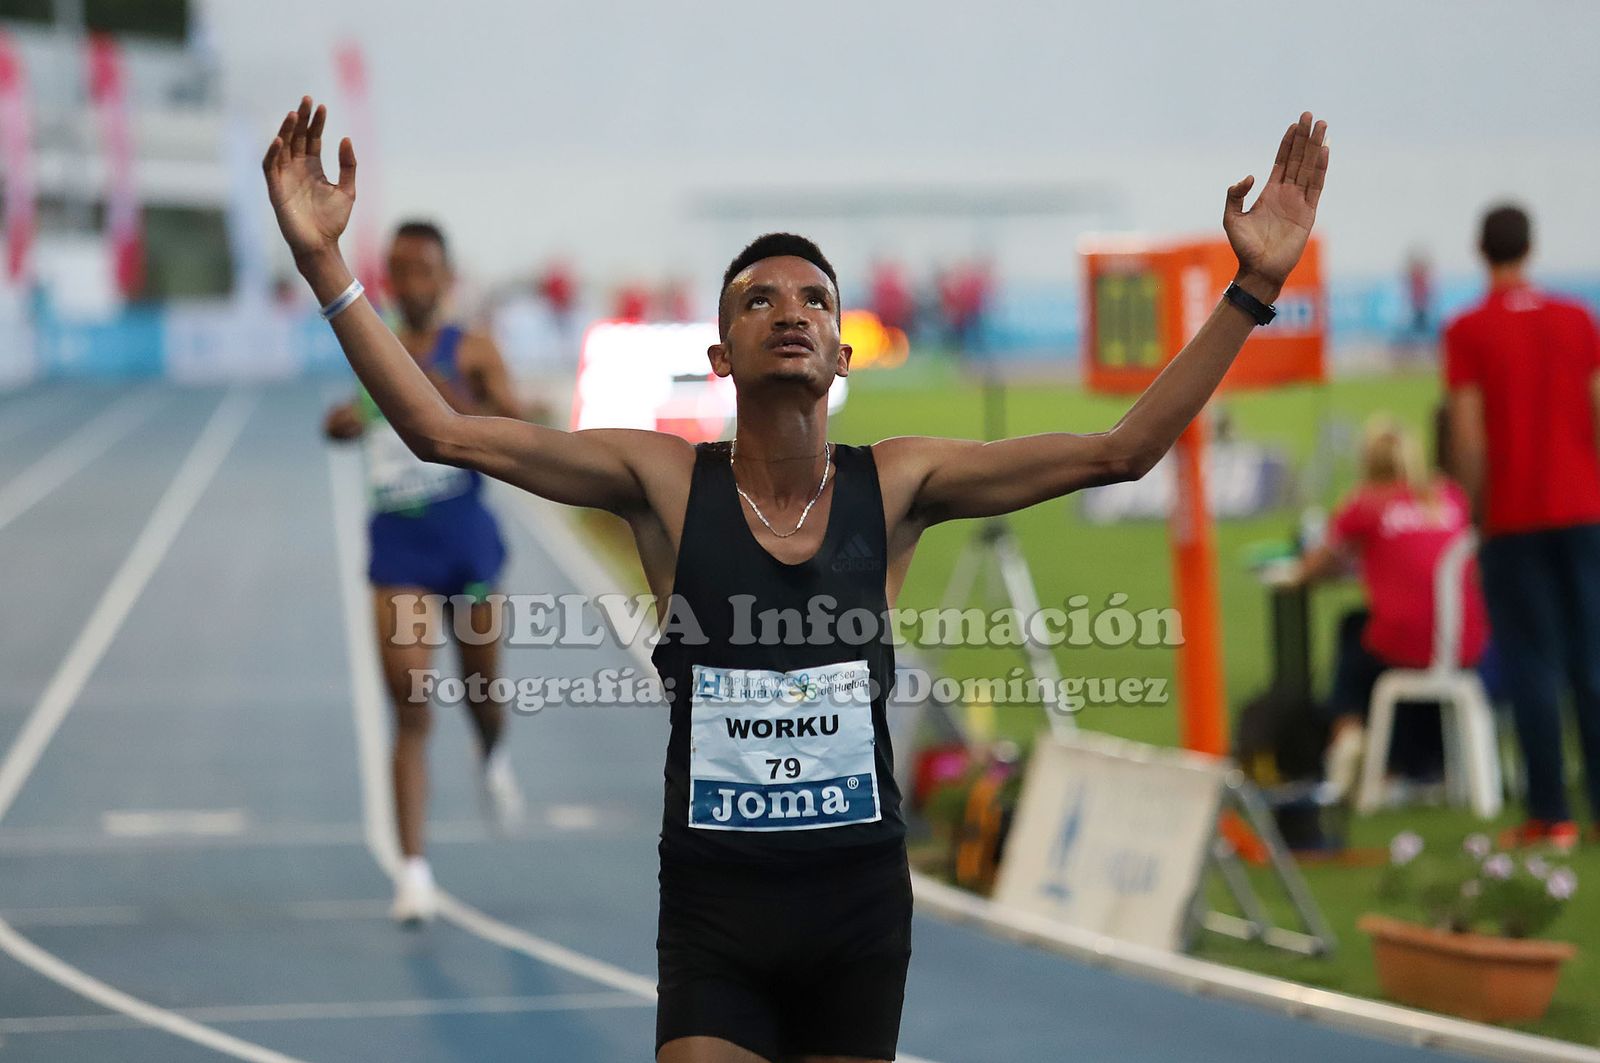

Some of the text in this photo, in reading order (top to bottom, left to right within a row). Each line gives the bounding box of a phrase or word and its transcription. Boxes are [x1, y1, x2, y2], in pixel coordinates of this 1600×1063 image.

[840, 670, 855, 680] sea
[723, 687, 784, 699] DE HUELVA
[820, 685, 833, 696] de
[725, 714, 839, 739] WORKU
[765, 757, 801, 780] 79
